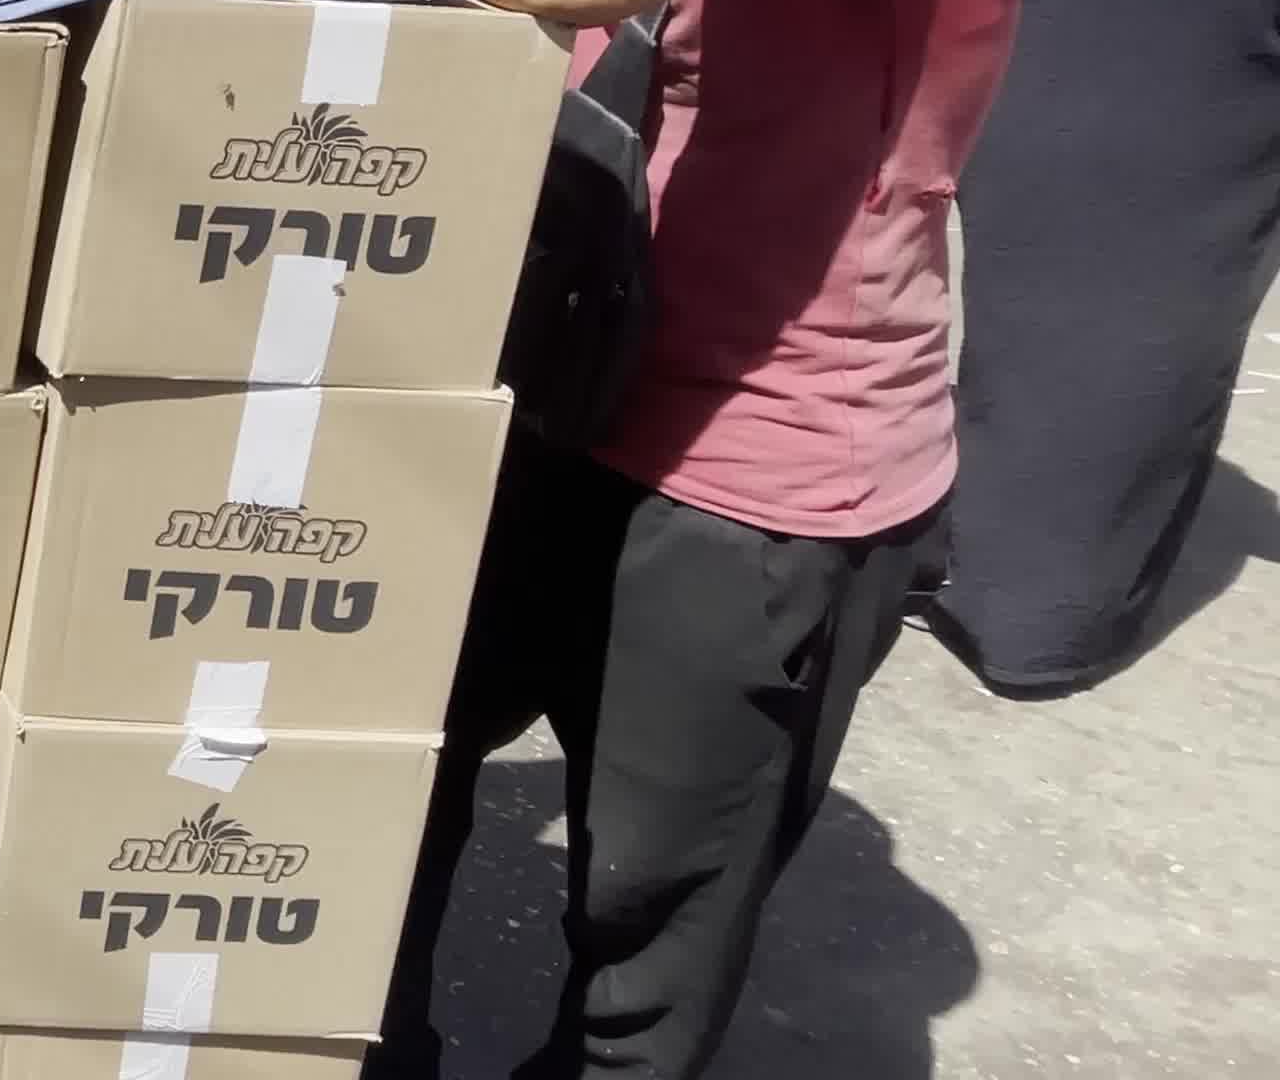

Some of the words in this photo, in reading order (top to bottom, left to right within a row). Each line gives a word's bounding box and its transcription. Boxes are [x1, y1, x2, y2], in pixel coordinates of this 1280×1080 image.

[210, 127, 321, 183] עלית
[322, 143, 428, 196] קפה
[173, 203, 437, 284] טורקי
[155, 501, 264, 552] עלית
[263, 514, 368, 564] קפה
[123, 567, 380, 640] טורקי
[108, 827, 210, 874] עלית
[210, 840, 310, 884] קפה
[78, 889, 321, 953] טורקי
